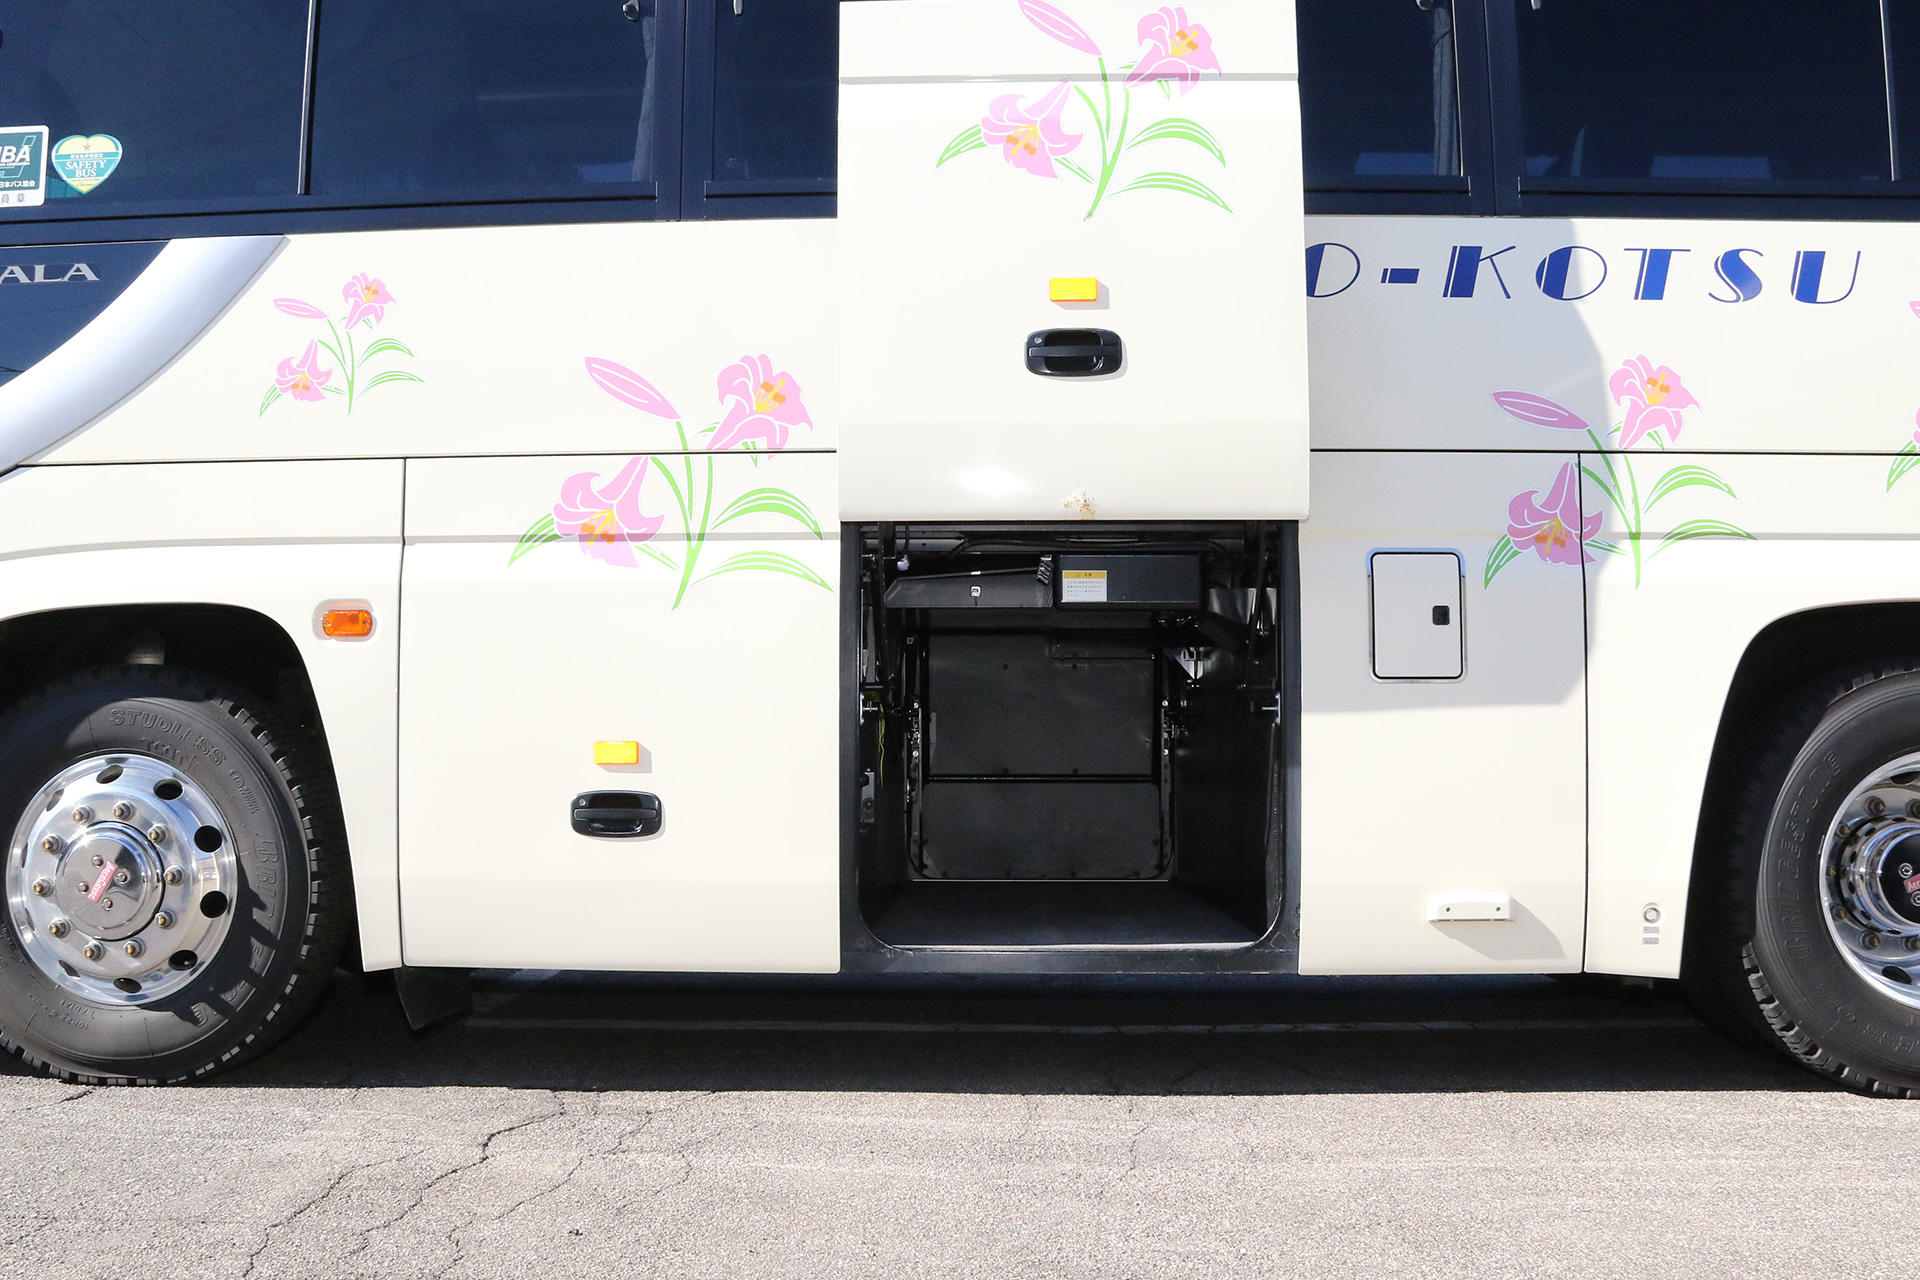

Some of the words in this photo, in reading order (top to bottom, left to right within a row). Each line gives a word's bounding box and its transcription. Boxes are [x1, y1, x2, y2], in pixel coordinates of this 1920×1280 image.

[0, 145, 31, 163] BA
[65, 160, 107, 170] SAFETY
[75, 168, 97, 178] BUS
[0, 263, 100, 283] ALA
[109, 708, 226, 766] STUDLESS
